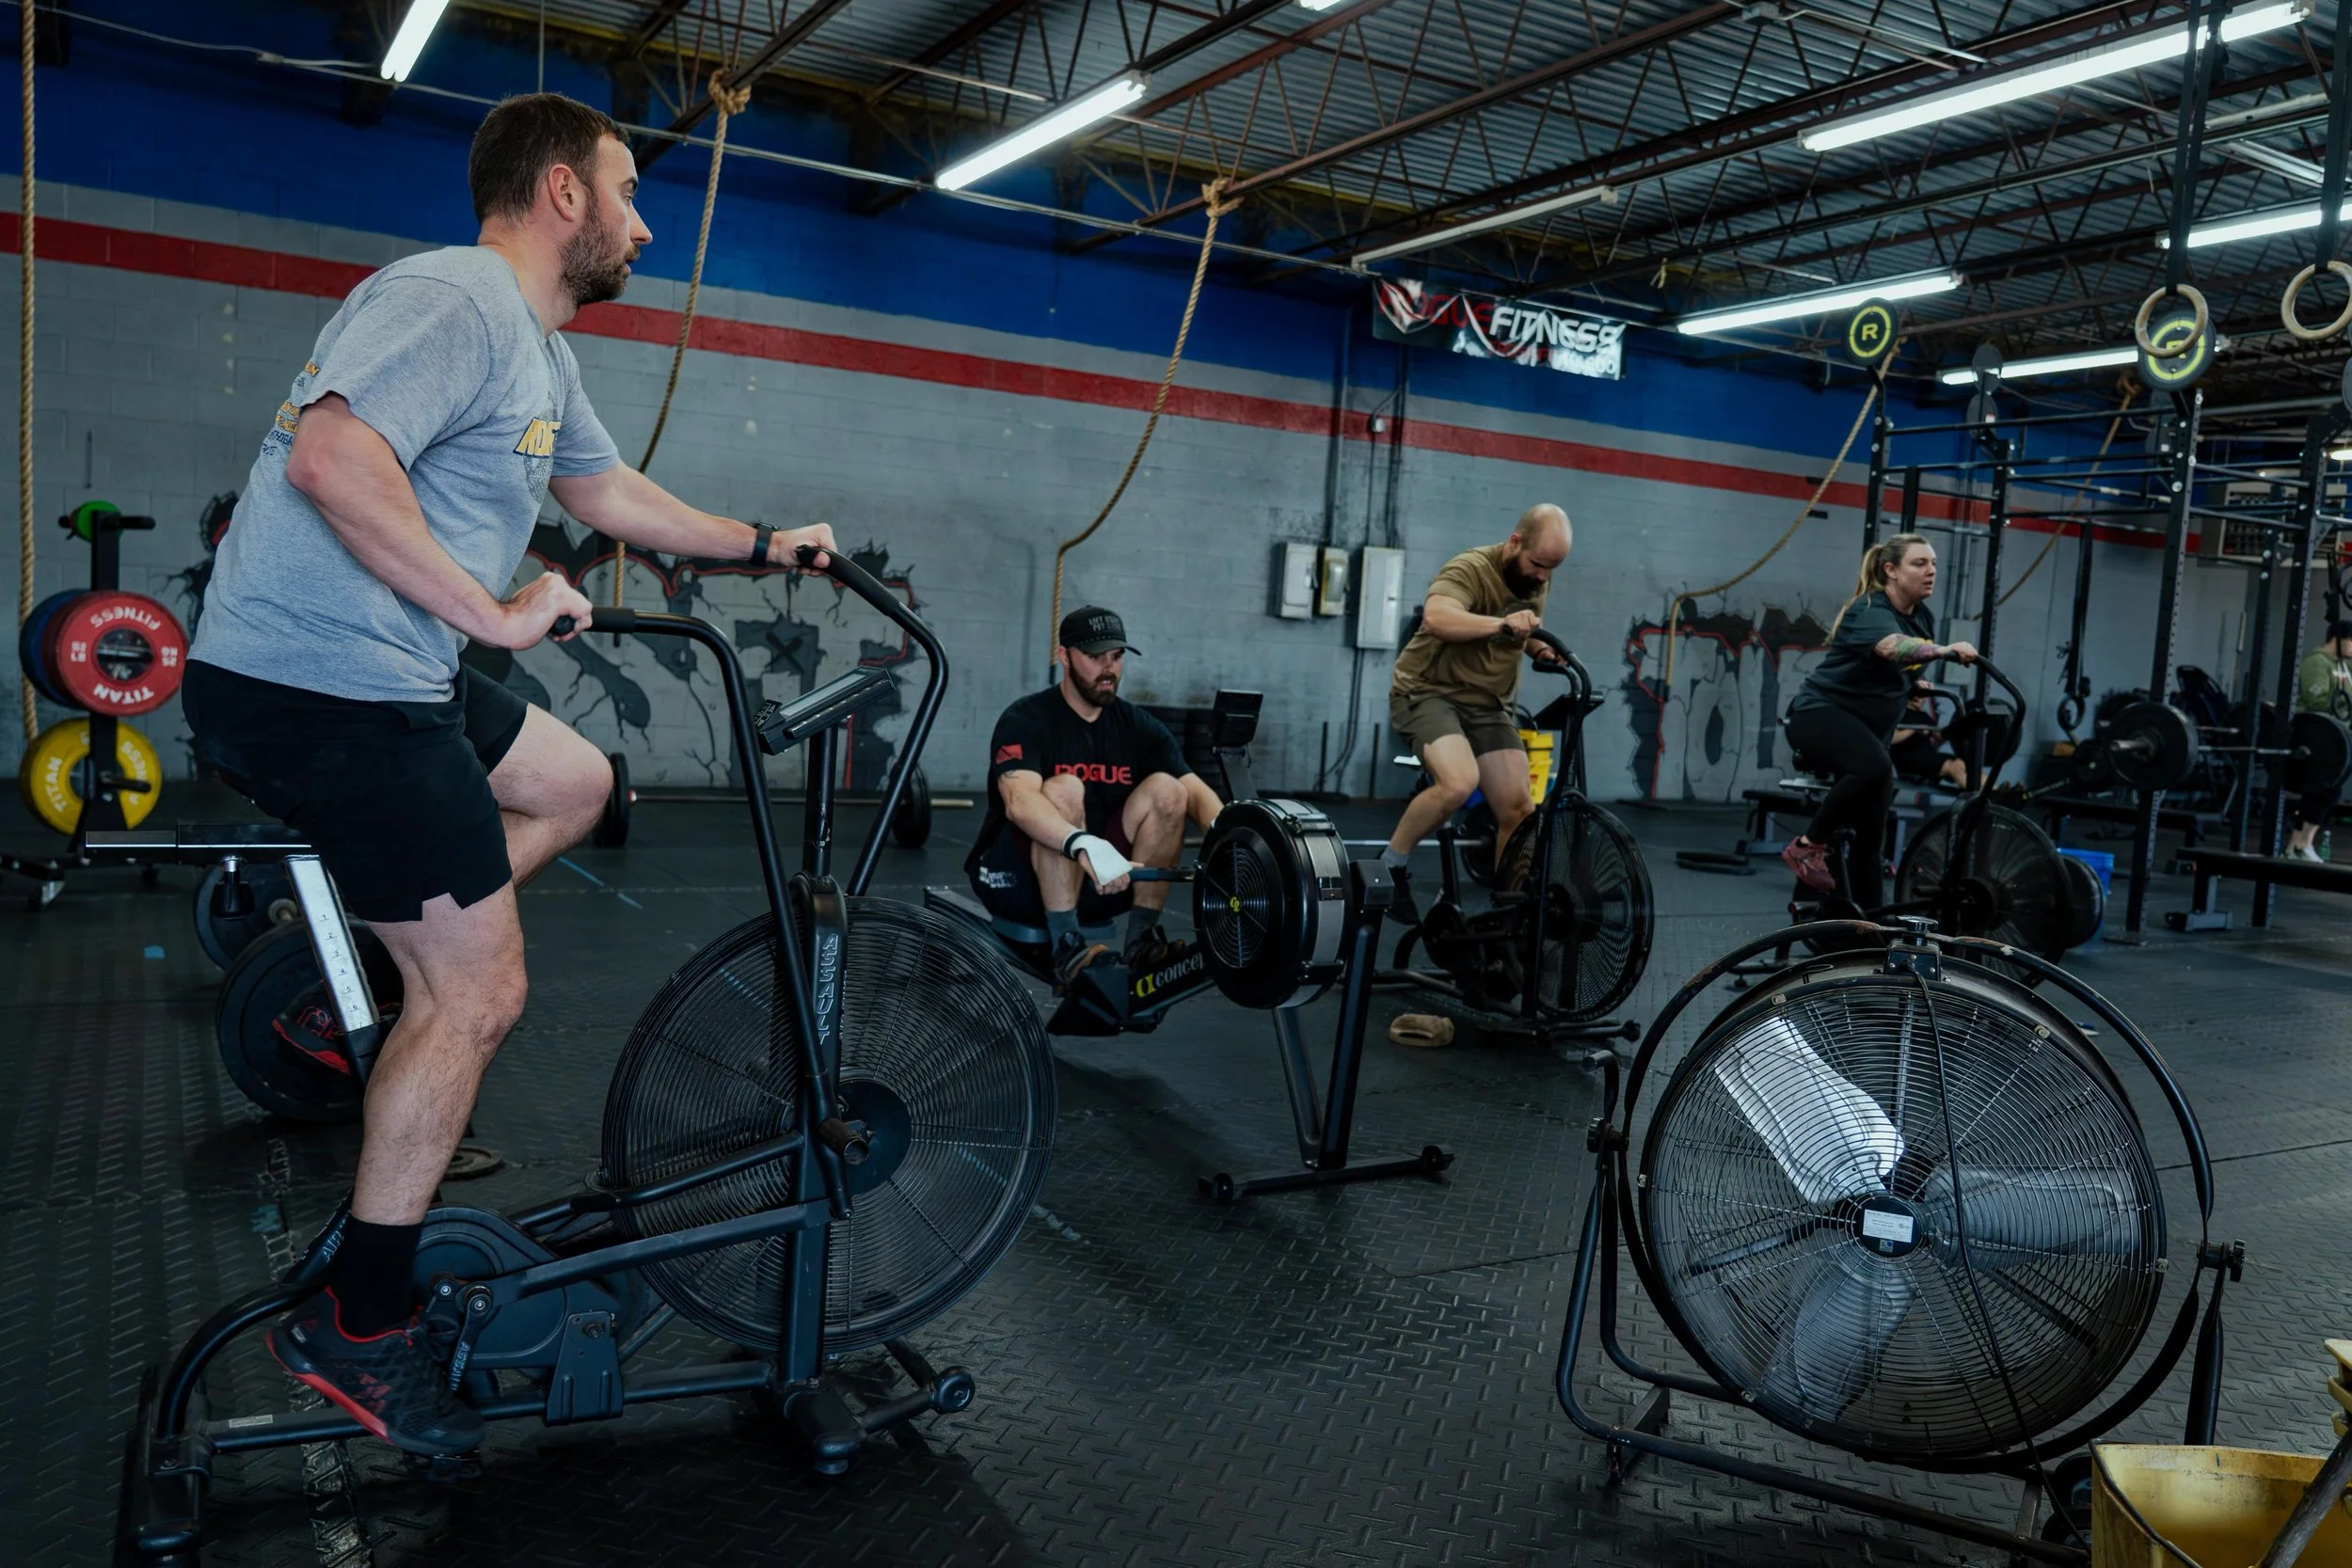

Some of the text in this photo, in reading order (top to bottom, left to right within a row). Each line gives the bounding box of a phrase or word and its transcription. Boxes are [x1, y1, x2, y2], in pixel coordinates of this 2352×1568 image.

[1489, 306, 1623, 354] FITNESS
[1862, 324, 1879, 341] R
[89, 606, 162, 631] FITNESS
[92, 683, 155, 705] TITAN
[44, 756, 68, 813] TITAN
[120, 740, 147, 806] FNESS
[816, 933, 838, 1045] ASSAULT
